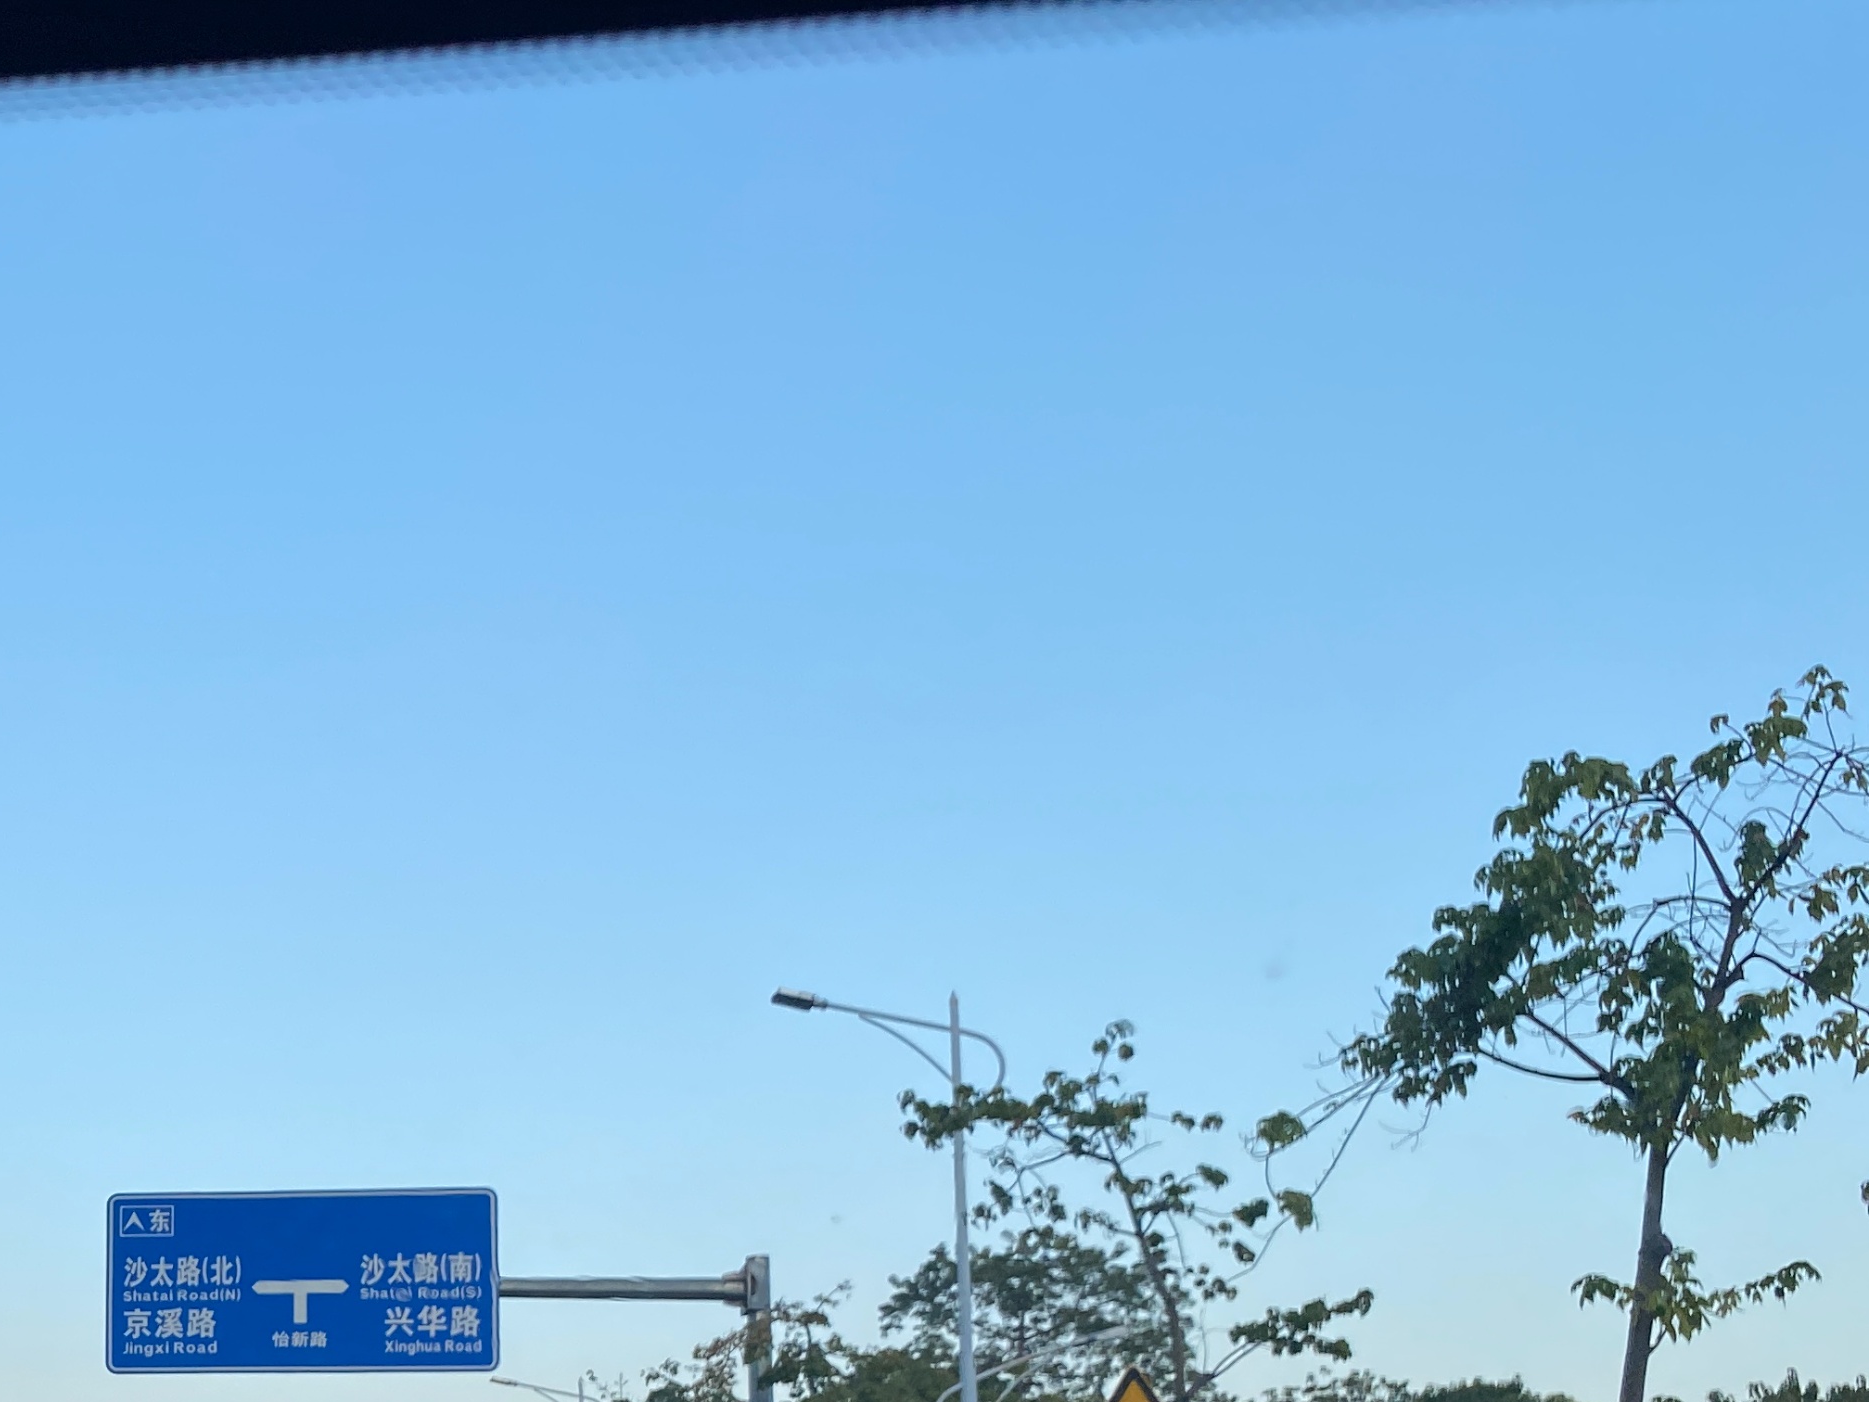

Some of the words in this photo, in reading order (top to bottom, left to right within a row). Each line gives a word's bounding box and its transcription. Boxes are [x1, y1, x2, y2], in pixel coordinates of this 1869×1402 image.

[149, 1209, 170, 1232] 东
[124, 1256, 242, 1287] 沙太路(北)
[360, 1252, 482, 1285] 沙太路(南)
[177, 1288, 241, 1302] Road(N)
[360, 1287, 412, 1301] Shati
[123, 1308, 216, 1338] 京溪路
[385, 1305, 480, 1337] 兴华路
[123, 1341, 169, 1357] Jingxi
[174, 1341, 218, 1354] Road
[272, 1331, 327, 1348] 怡新路
[385, 1340, 441, 1356] Xinghua
[445, 1340, 482, 1354] Road
